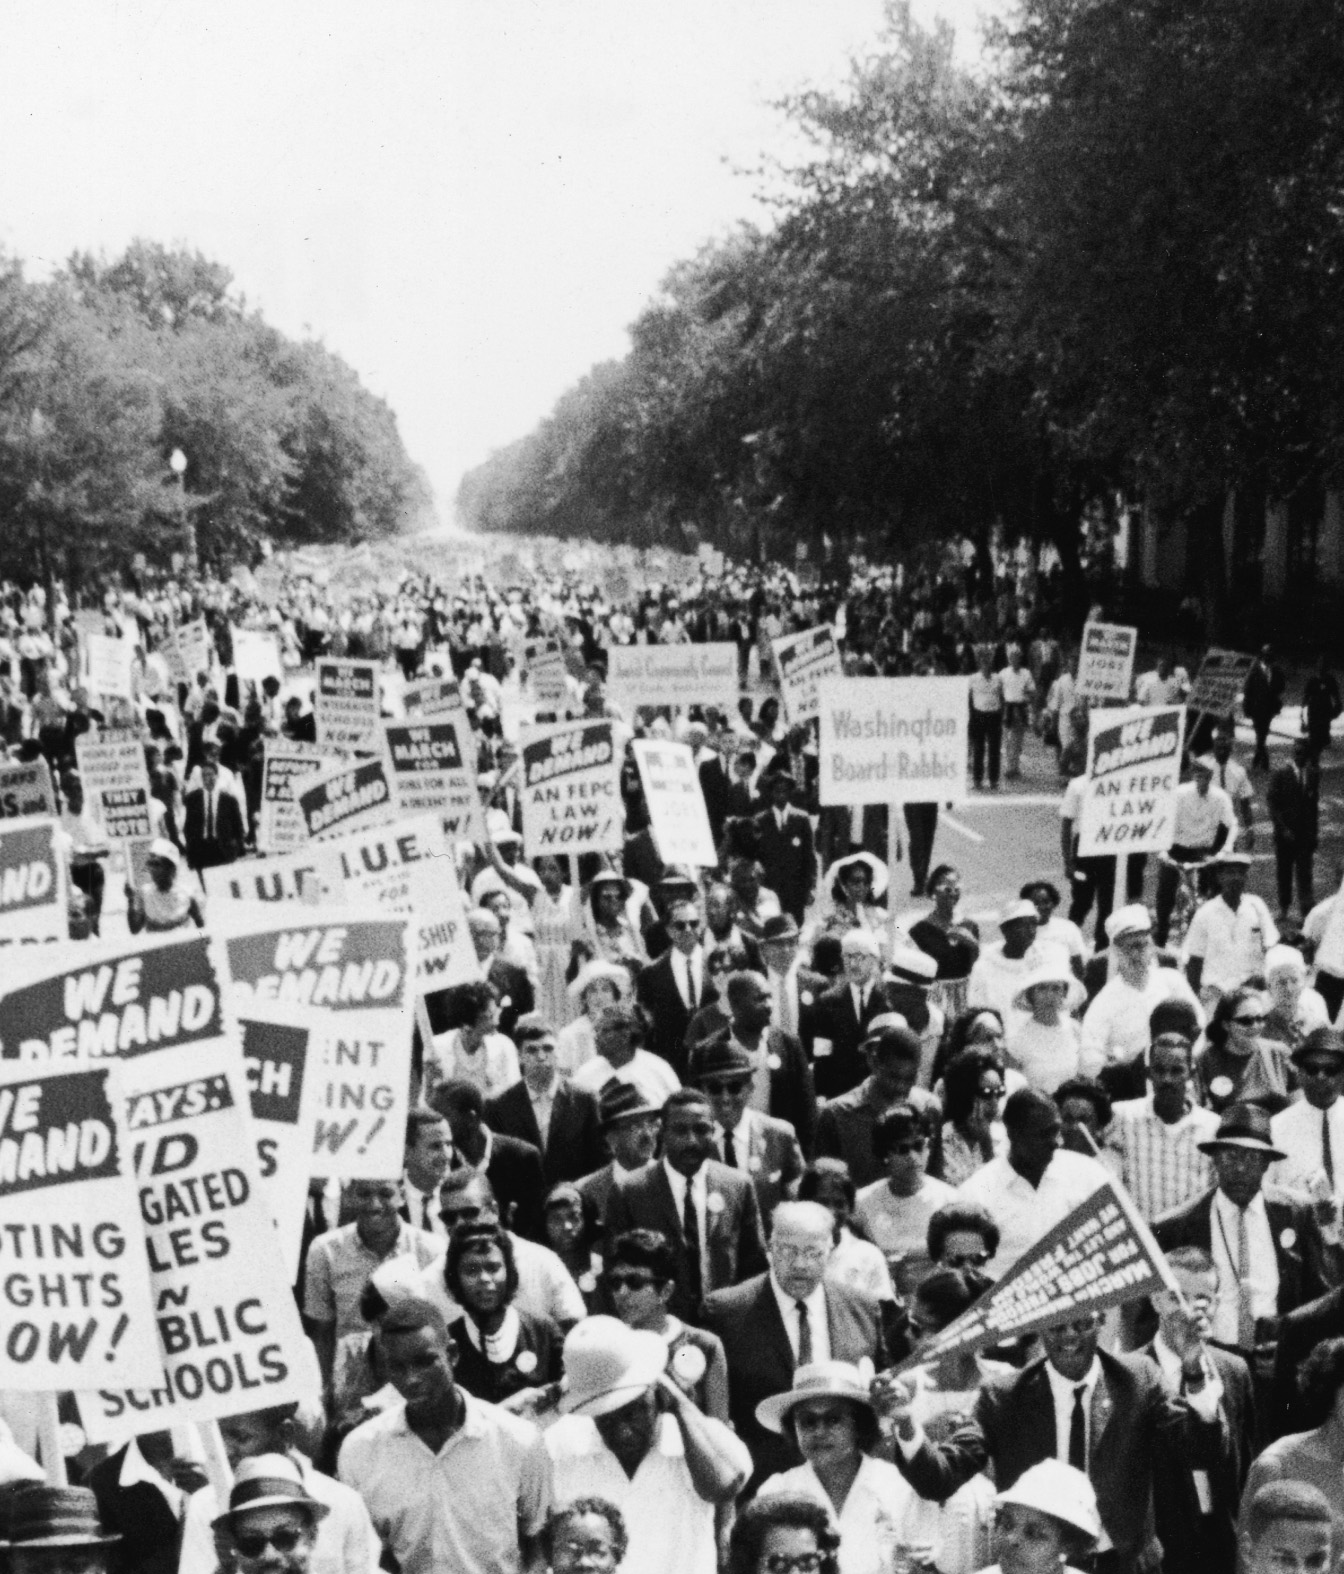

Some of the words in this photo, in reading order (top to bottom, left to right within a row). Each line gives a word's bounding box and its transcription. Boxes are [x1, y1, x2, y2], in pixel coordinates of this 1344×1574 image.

[831, 709, 957, 745] Washington
[393, 742, 457, 760] MARCH
[832, 752, 887, 782] Board
[532, 787, 560, 803] AN
[567, 780, 614, 799] FEPC
[1096, 777, 1120, 796] AN
[1130, 774, 1171, 792] FEPC
[551, 804, 598, 821] LAW
[1110, 799, 1155, 818] LAW
[540, 819, 613, 844] NOW!
[1095, 814, 1168, 843] NOW!
[340, 834, 431, 880] I.U.E.
[274, 926, 348, 971] WE
[63, 956, 144, 1021] WE
[18, 984, 215, 1059] DEMAND
[138, 1167, 250, 1226] GATED
[145, 1220, 231, 1274] LES
[1108, 1238, 1140, 1265] FOR
[1056, 1252, 1106, 1295] JOBS
[1087, 1258, 1153, 1299] MARCH
[158, 1298, 268, 1355] BLIC
